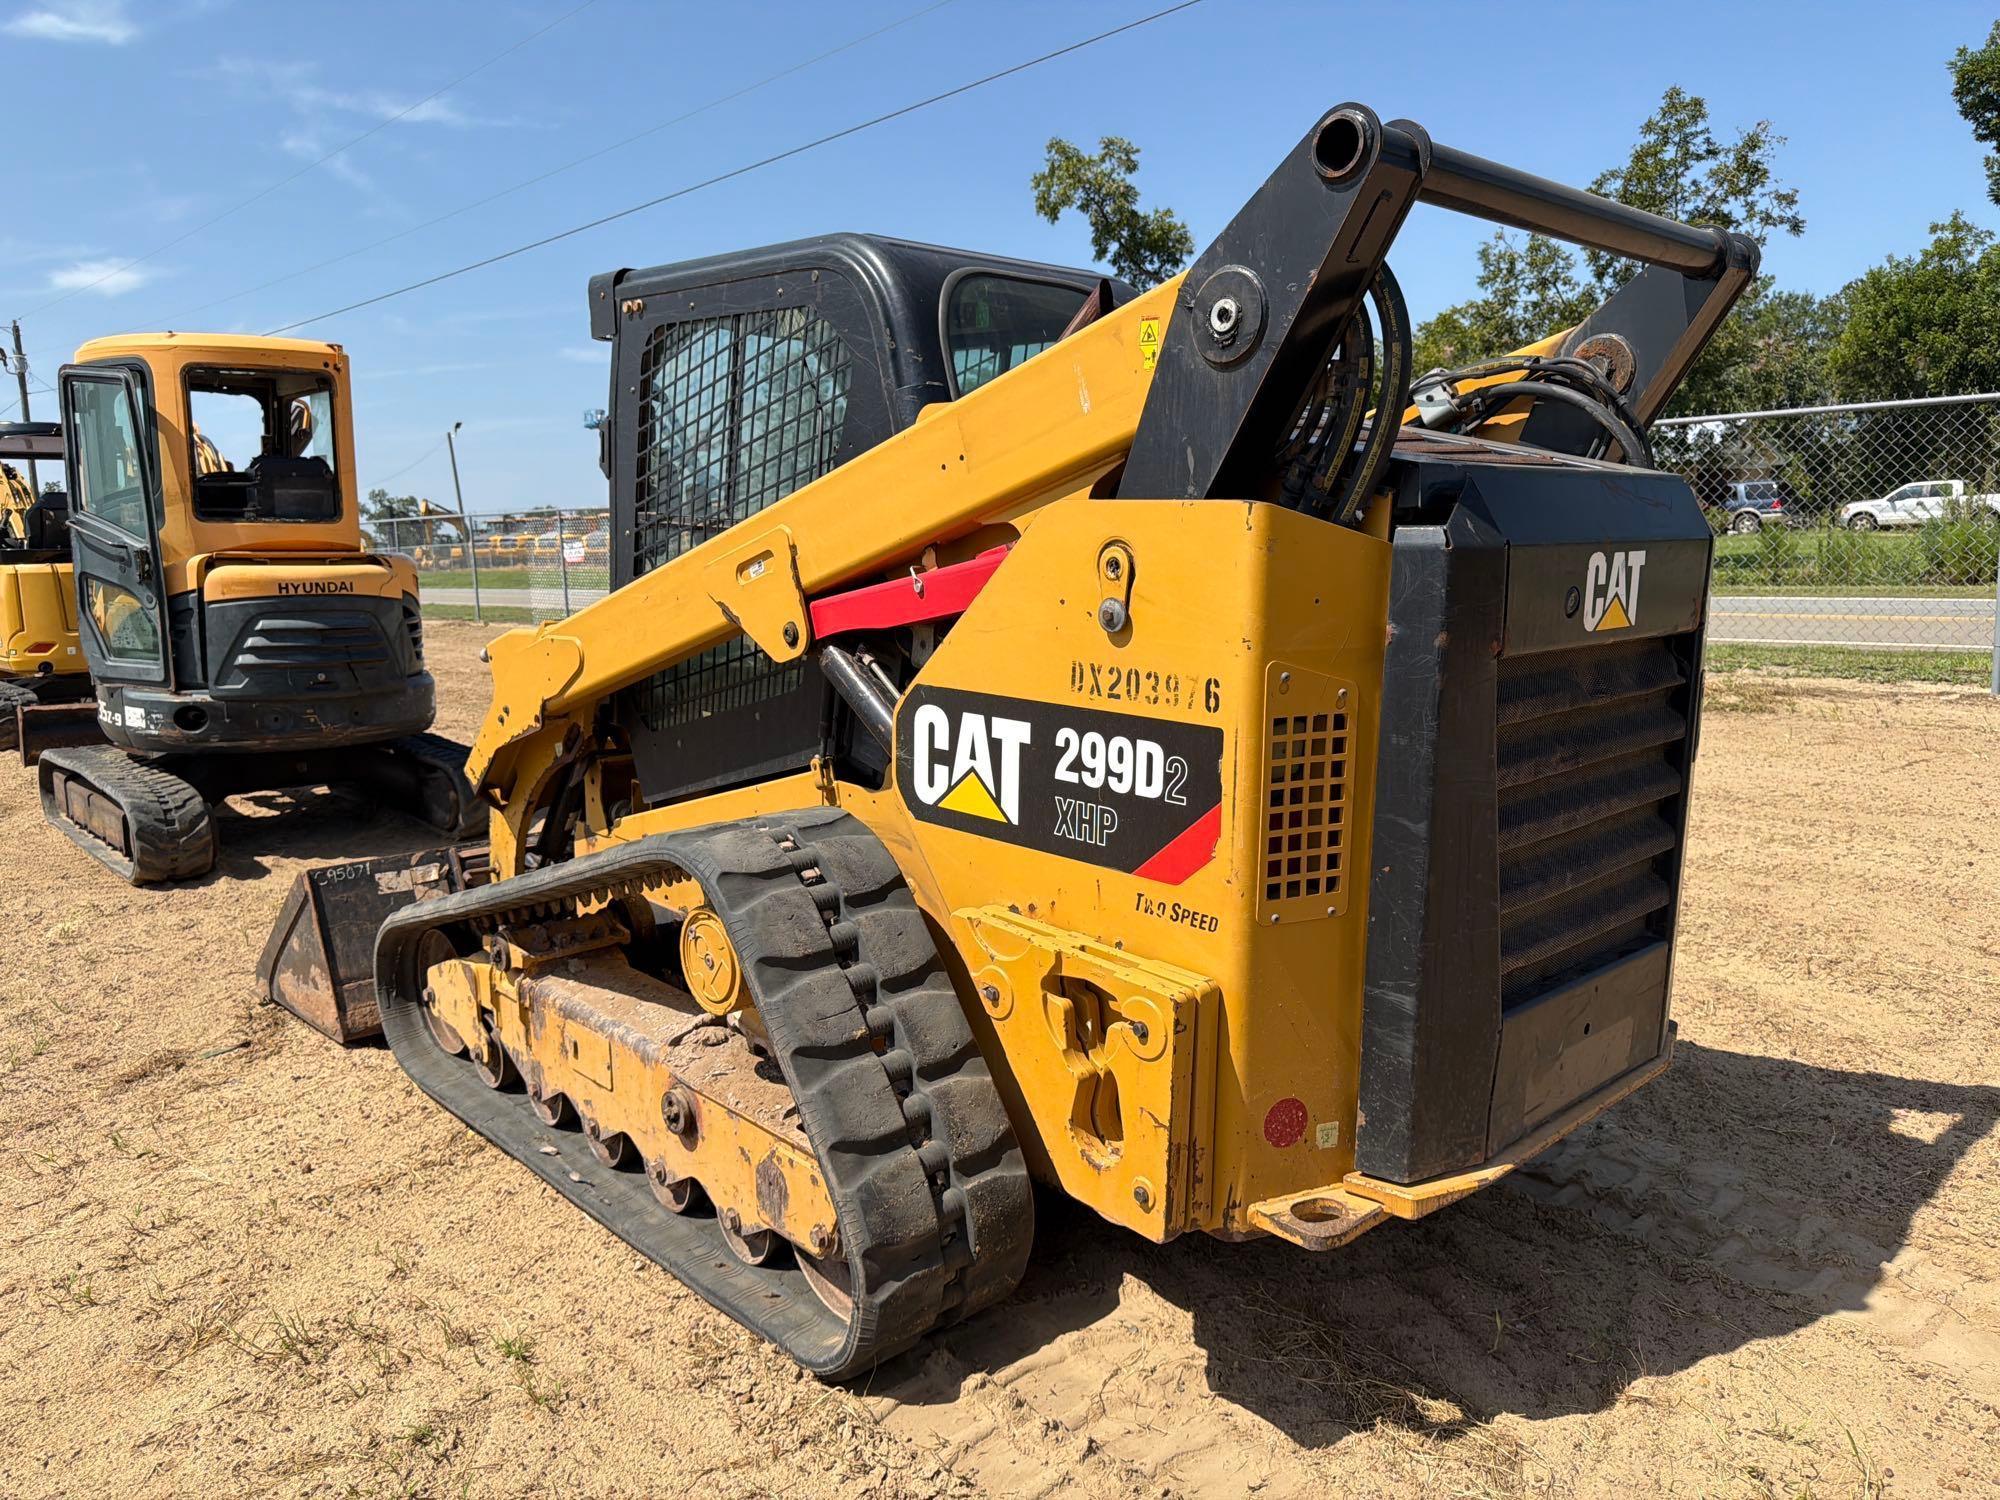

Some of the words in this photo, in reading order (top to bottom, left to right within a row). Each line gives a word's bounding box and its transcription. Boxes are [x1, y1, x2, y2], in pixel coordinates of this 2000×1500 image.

[278, 581, 354, 594] HYUNDAI
[1583, 550, 1647, 632] CAT
[913, 703, 1031, 826] CAT
[1054, 795, 1118, 847] XHP
